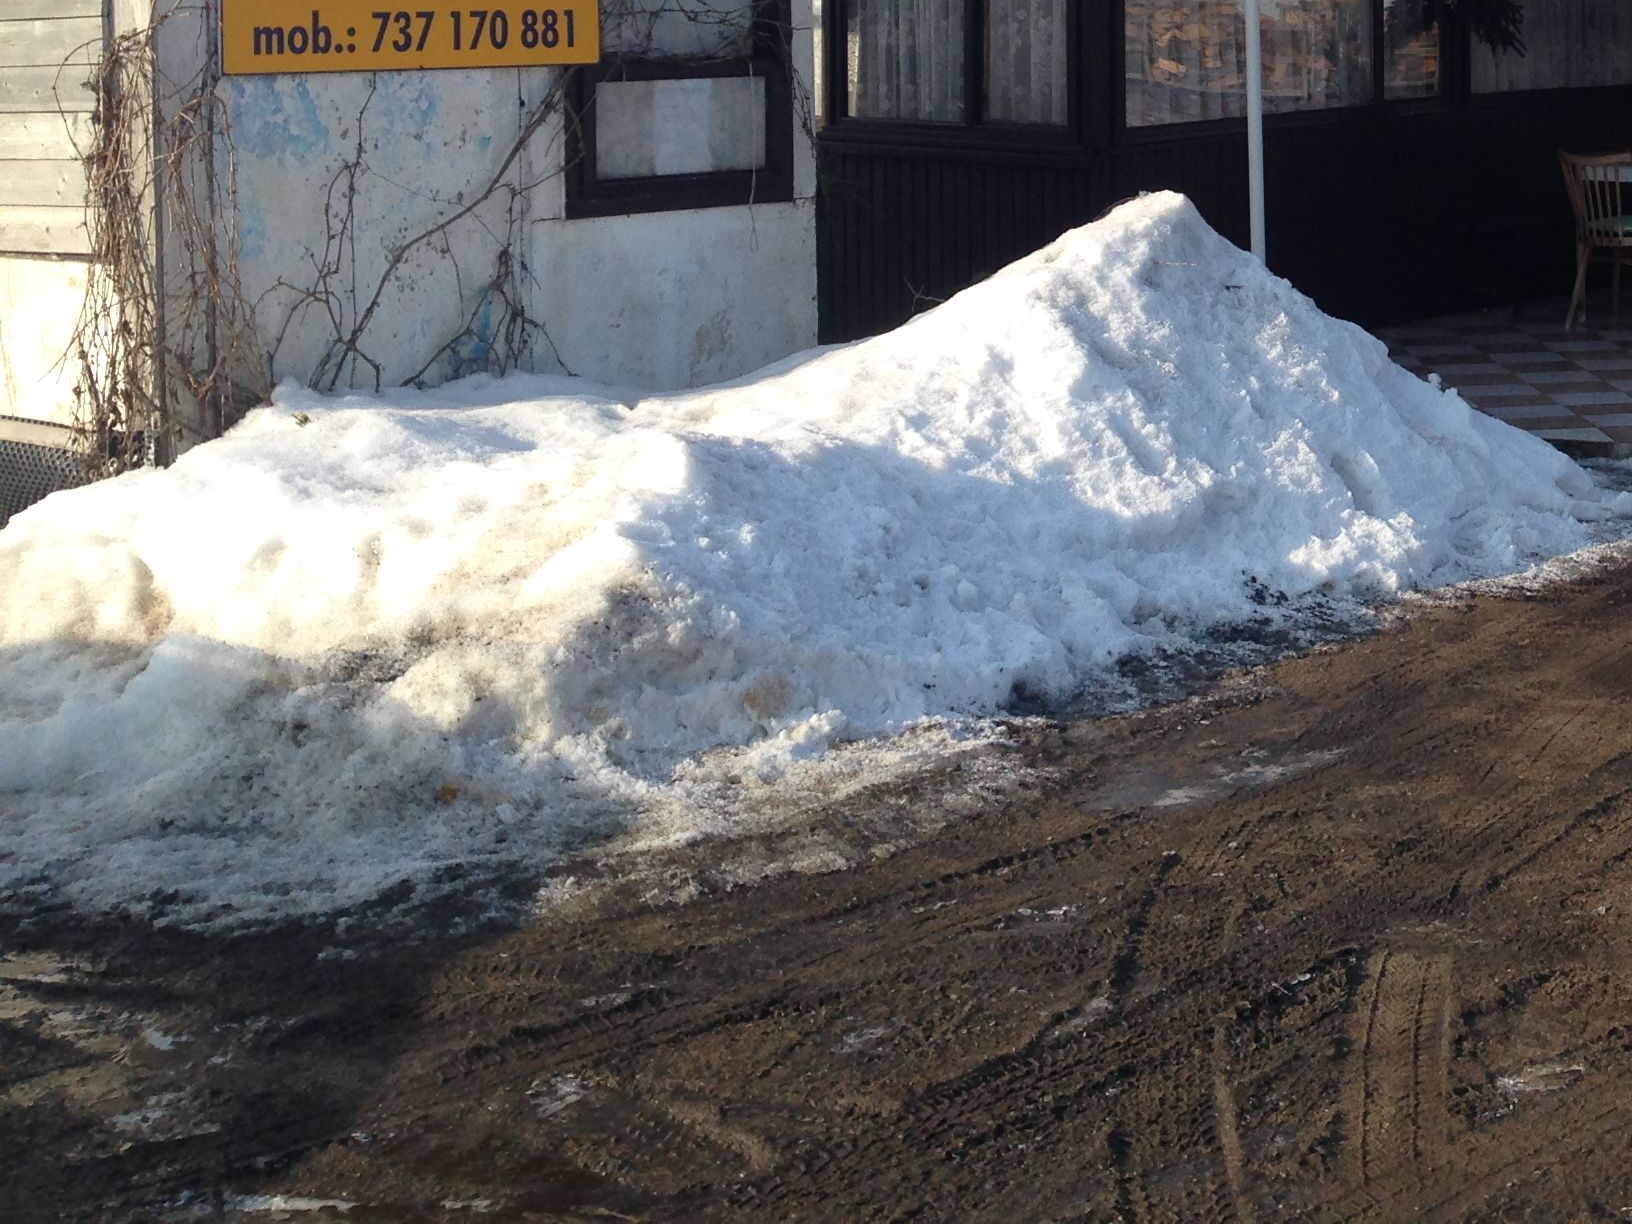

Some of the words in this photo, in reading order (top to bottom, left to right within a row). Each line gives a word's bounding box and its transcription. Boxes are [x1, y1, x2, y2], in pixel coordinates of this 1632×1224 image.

[253, 11, 356, 55] mob.:
[371, 11, 435, 53] 737
[450, 10, 508, 50] 170
[520, 9, 575, 48] 881
